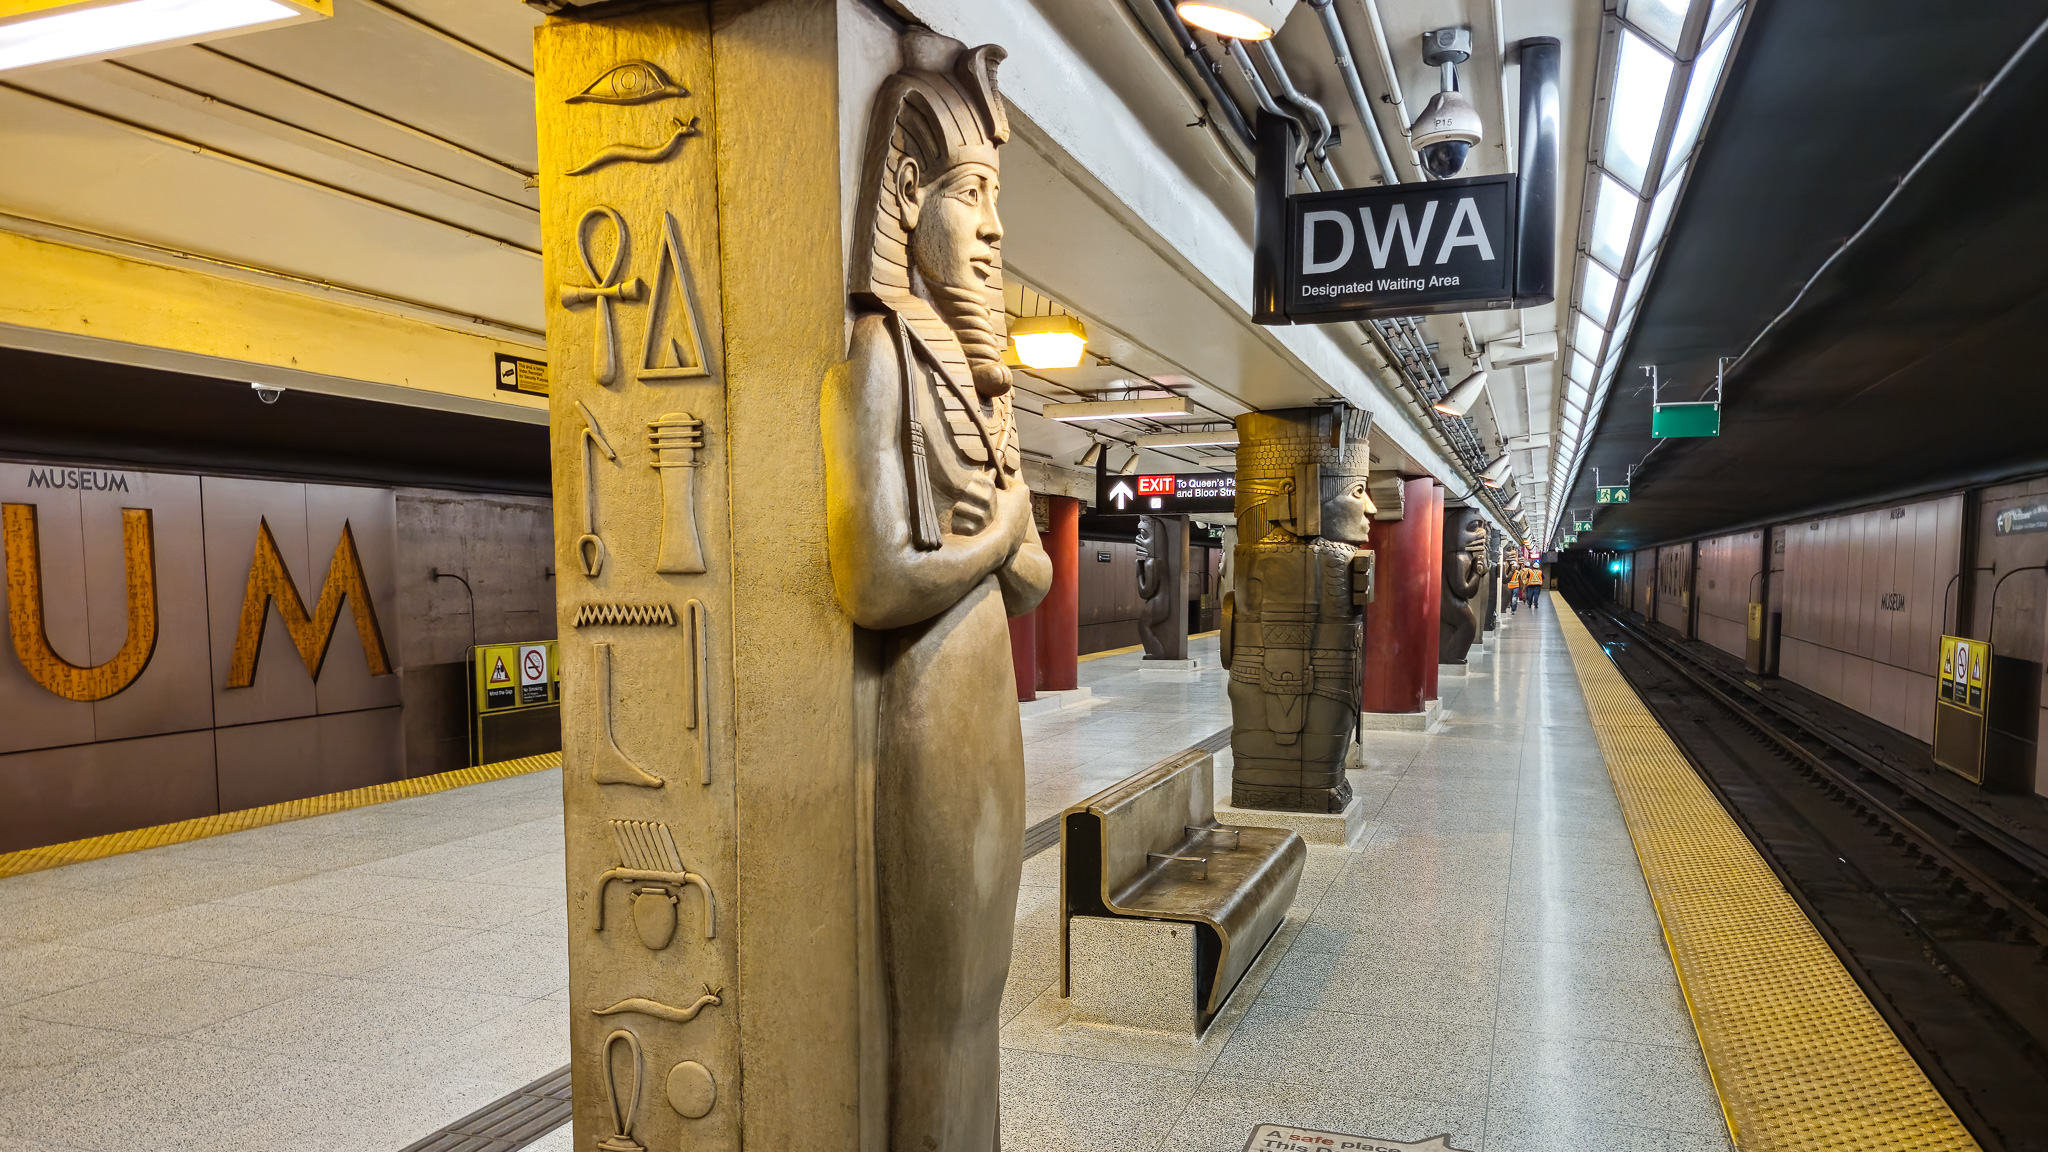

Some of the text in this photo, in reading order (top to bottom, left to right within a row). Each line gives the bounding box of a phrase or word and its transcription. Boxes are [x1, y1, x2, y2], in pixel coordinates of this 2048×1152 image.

[1302, 197, 1496, 275] DWA
[1302, 275, 1460, 297] Designated Waiting Area
[27, 468, 130, 493] MUSEUM
[1140, 478, 1173, 492] EXIT
[1177, 478, 1237, 488] To Queen's Pa
[1177, 487, 1237, 498] and Bloor Stre
[1881, 593, 1905, 613] MUSEUM
[1266, 1130, 1282, 1138] A
[1289, 1134, 1334, 1145] safe
[1263, 1139, 1309, 1152] This
